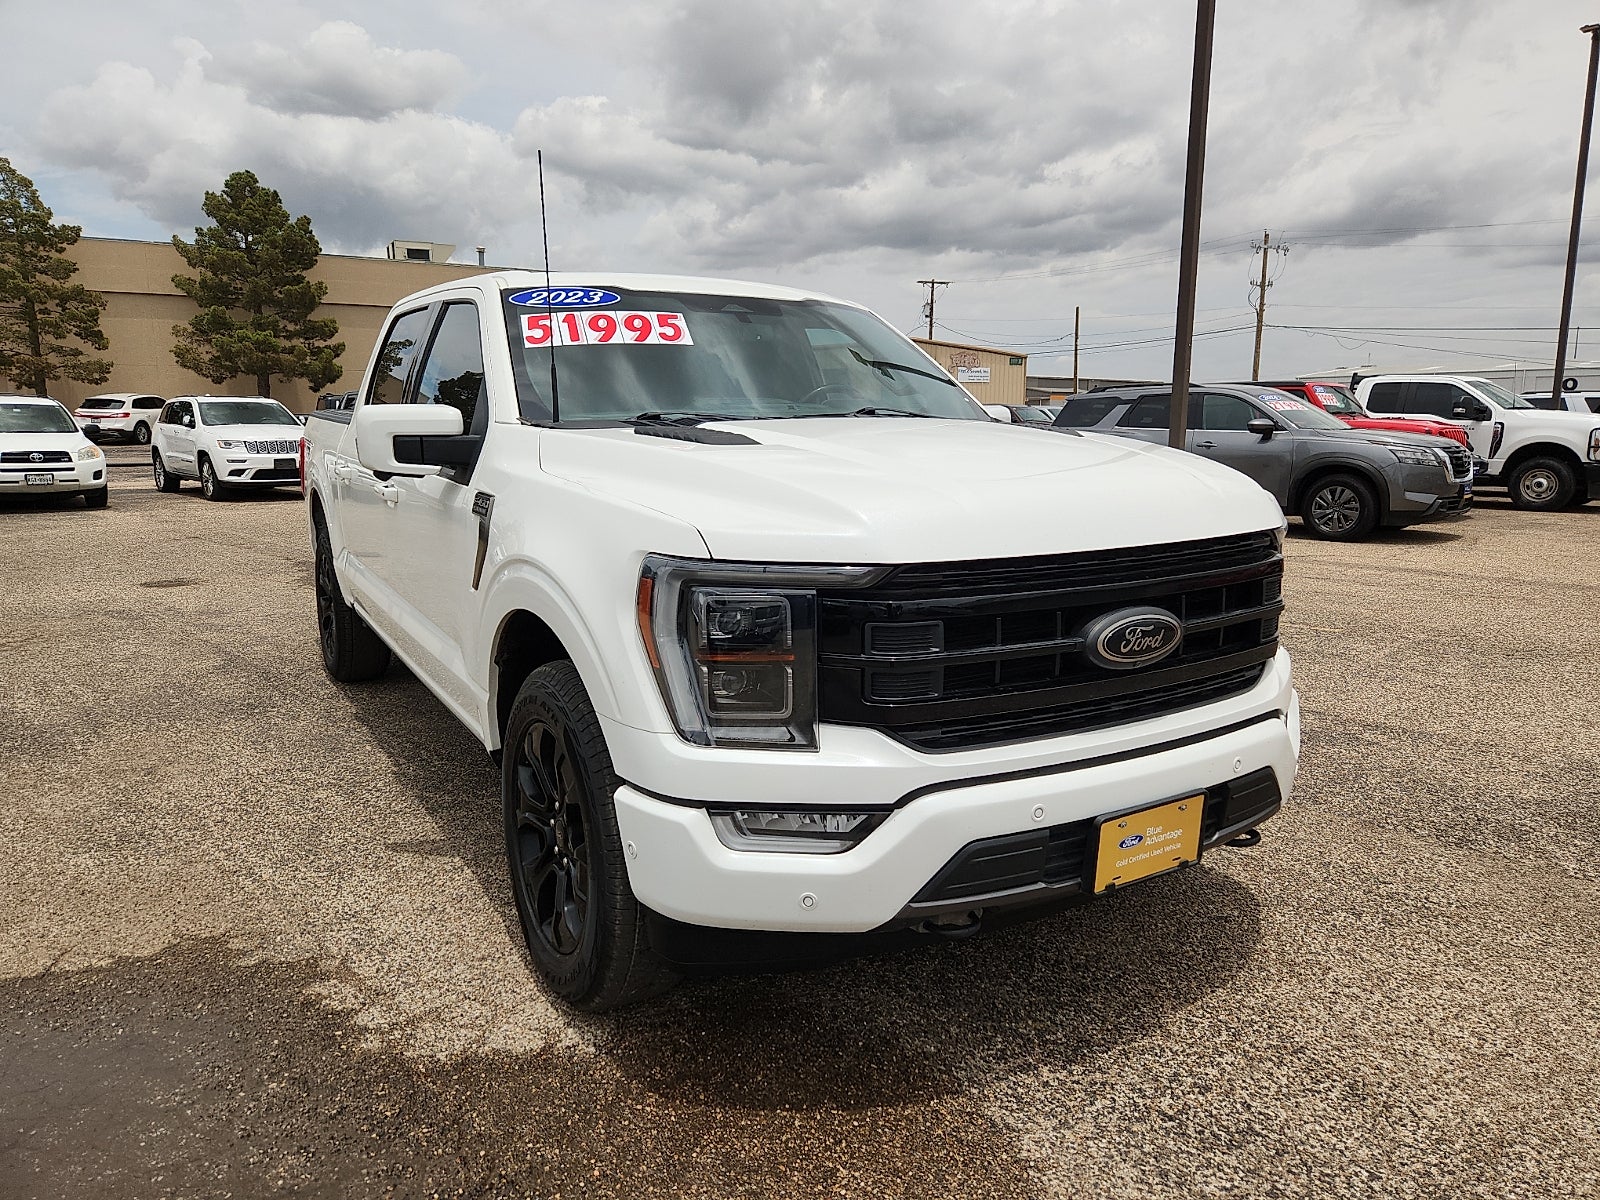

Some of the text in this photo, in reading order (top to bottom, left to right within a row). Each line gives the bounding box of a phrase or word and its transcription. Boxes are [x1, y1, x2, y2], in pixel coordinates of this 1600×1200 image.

[526, 290, 604, 305] 2023
[525, 312, 687, 346] 51995
[1120, 624, 1165, 653] Ford
[1145, 828, 1183, 846] Advantage
[1146, 825, 1163, 836] Blue
[1122, 836, 1140, 848] Ford
[1115, 842, 1181, 867] Gold Certified Used Vehicle
